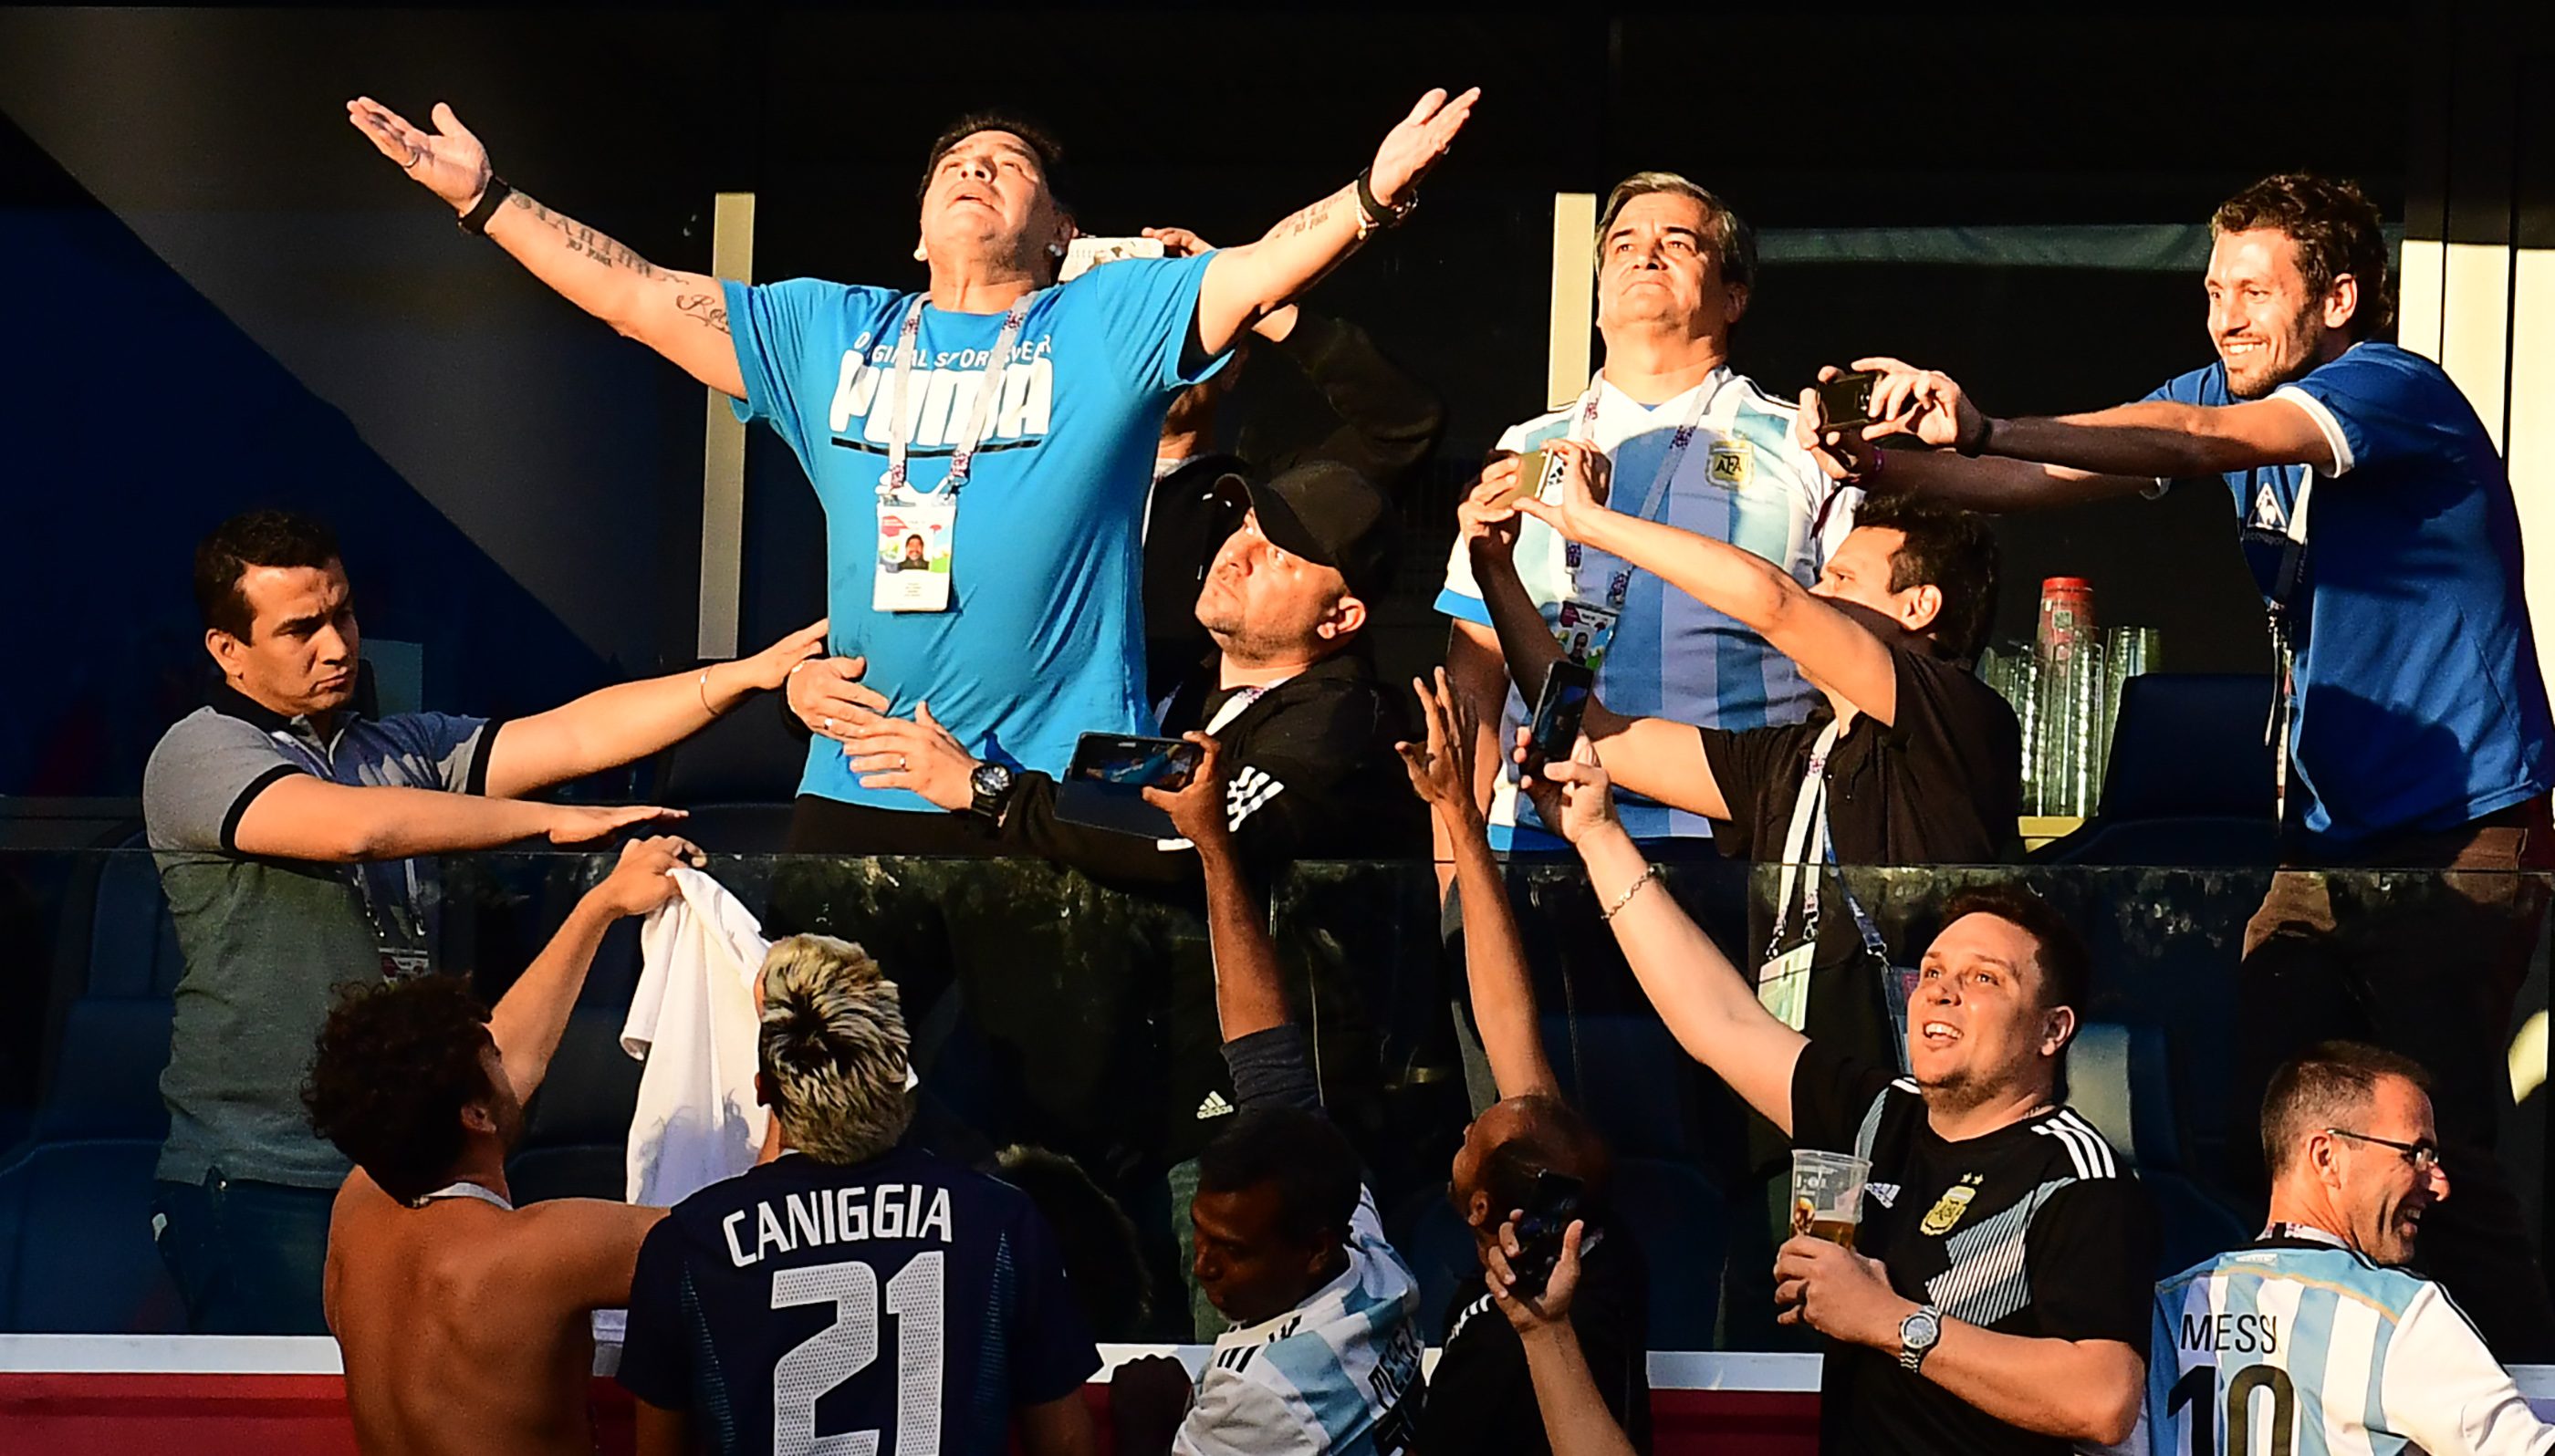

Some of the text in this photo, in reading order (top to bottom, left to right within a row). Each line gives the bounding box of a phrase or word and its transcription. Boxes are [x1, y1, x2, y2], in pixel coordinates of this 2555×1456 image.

[829, 349, 1054, 447] PUMA
[723, 1184, 953, 1268] CANIGGIA
[771, 1251, 944, 1456] 21
[2167, 1364, 2295, 1456] 10
